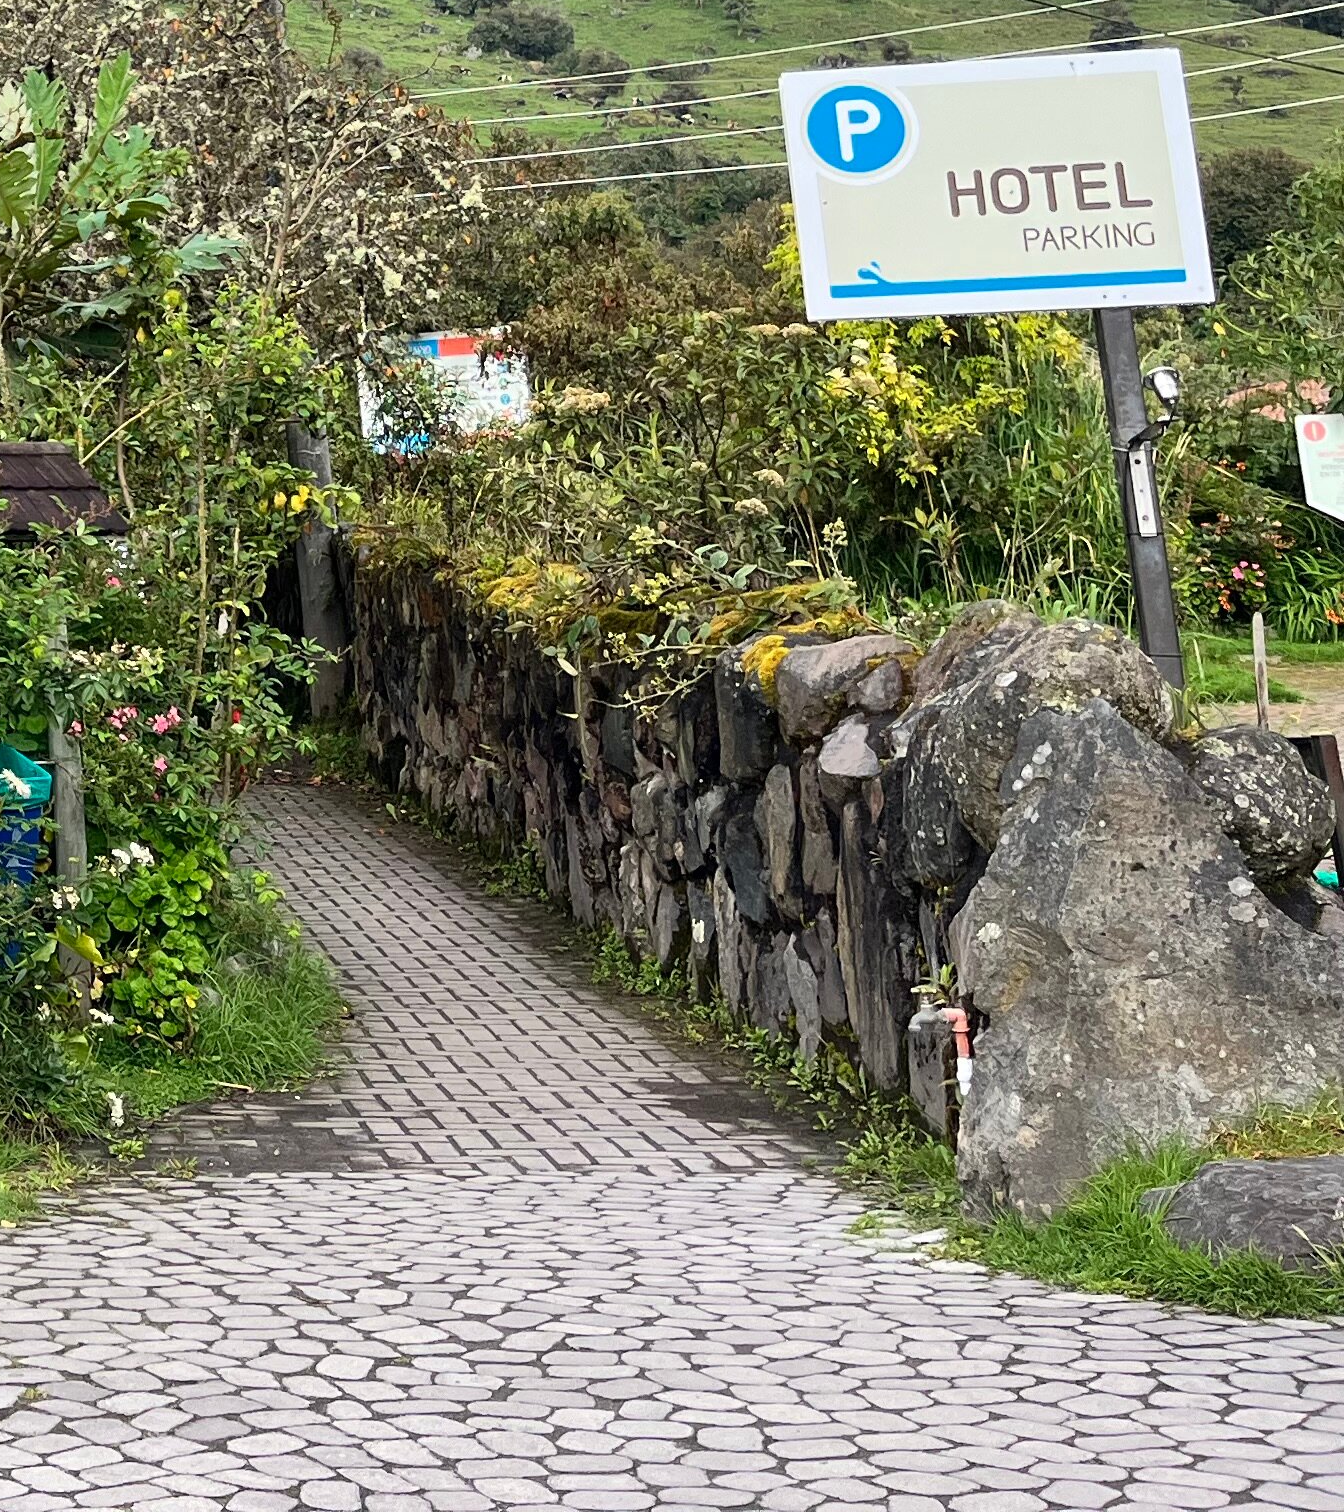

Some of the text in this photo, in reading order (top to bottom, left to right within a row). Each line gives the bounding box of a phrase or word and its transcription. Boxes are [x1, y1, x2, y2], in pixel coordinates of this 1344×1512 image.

[835, 99, 881, 162] P
[946, 161, 1153, 217] HOTEL
[1023, 222, 1155, 252] PARKING
